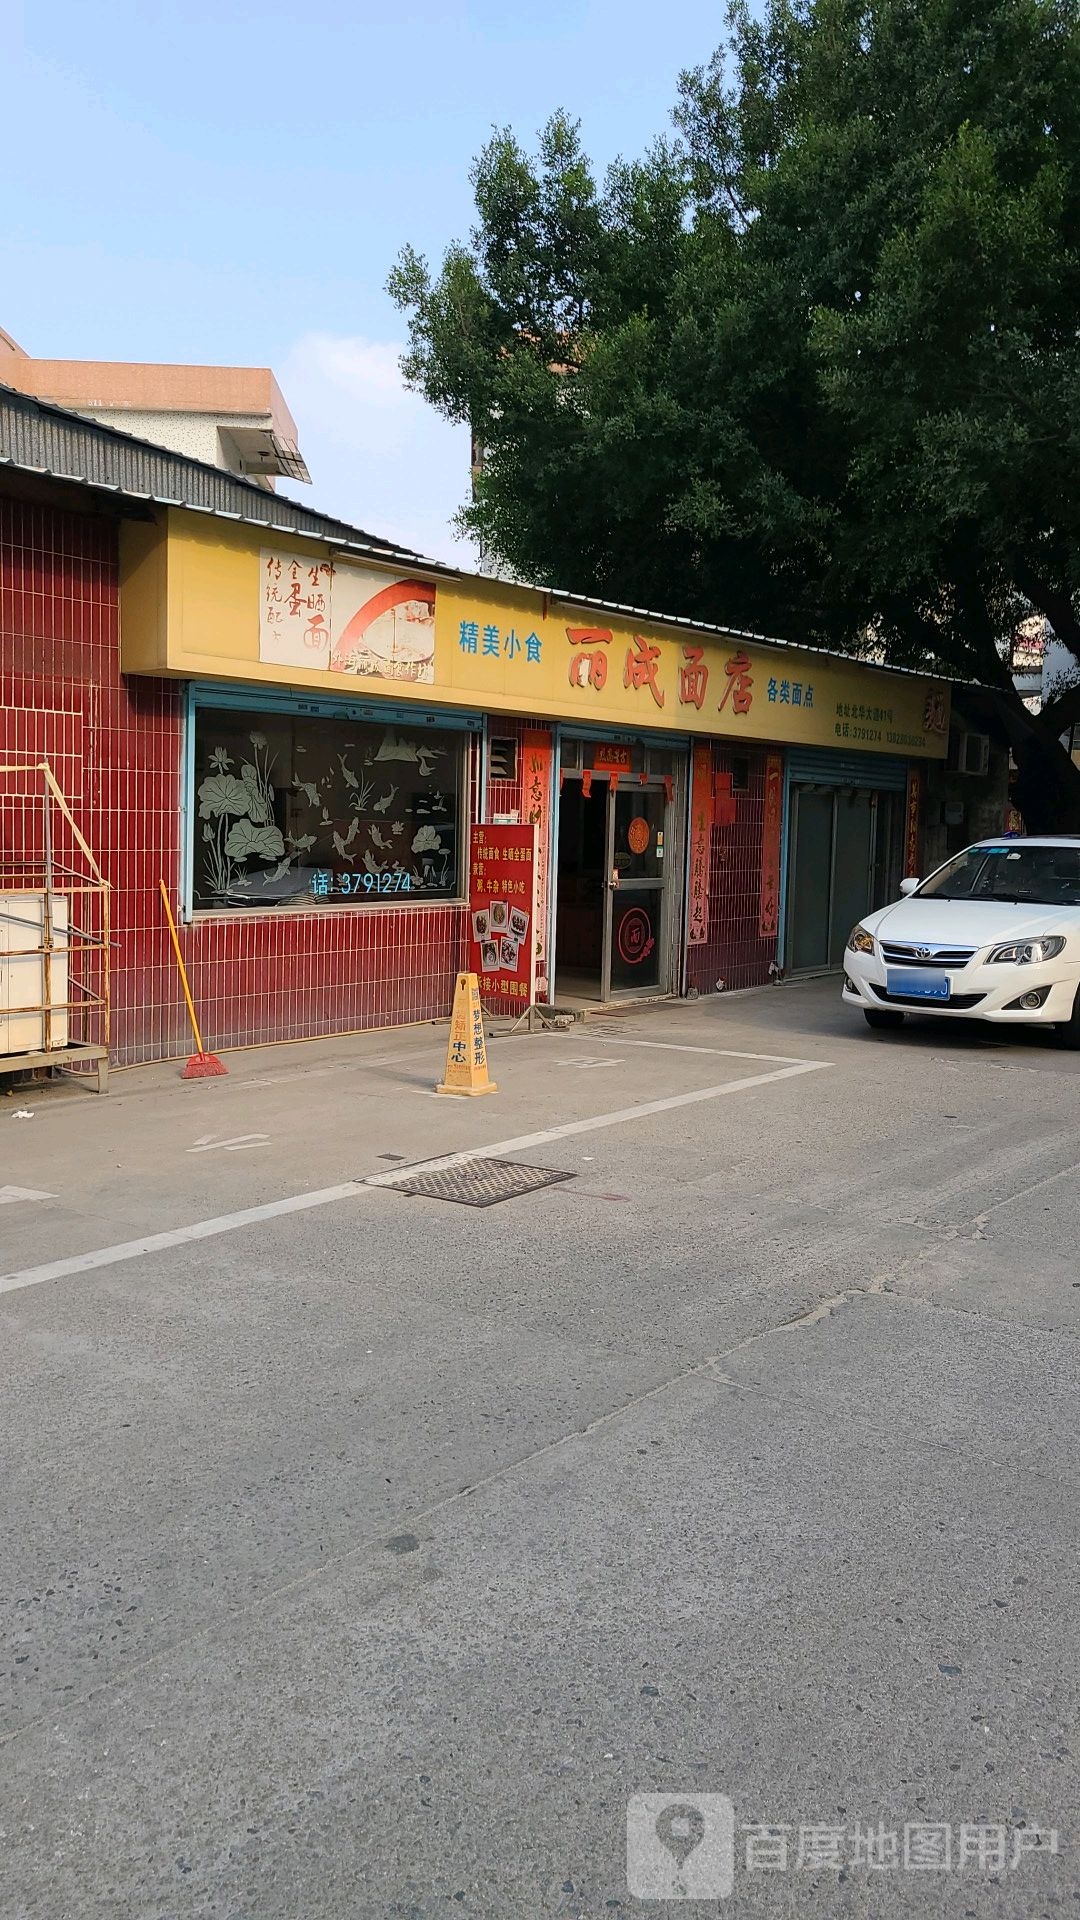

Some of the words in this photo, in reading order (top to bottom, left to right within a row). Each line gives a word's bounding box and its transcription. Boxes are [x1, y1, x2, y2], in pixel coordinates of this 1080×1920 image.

[459, 620, 542, 663] 精美小食
[565, 627, 754, 715] 丽成面店
[767, 676, 814, 708] 各类面点
[477, 847, 500, 860] 传统面食
[502, 847, 532, 862] 生晒全蛋面
[476, 879, 499, 893] 粥、牛杂
[501, 880, 526, 895] 特色小吃
[472, 1008, 486, 1065] 梦想整形
